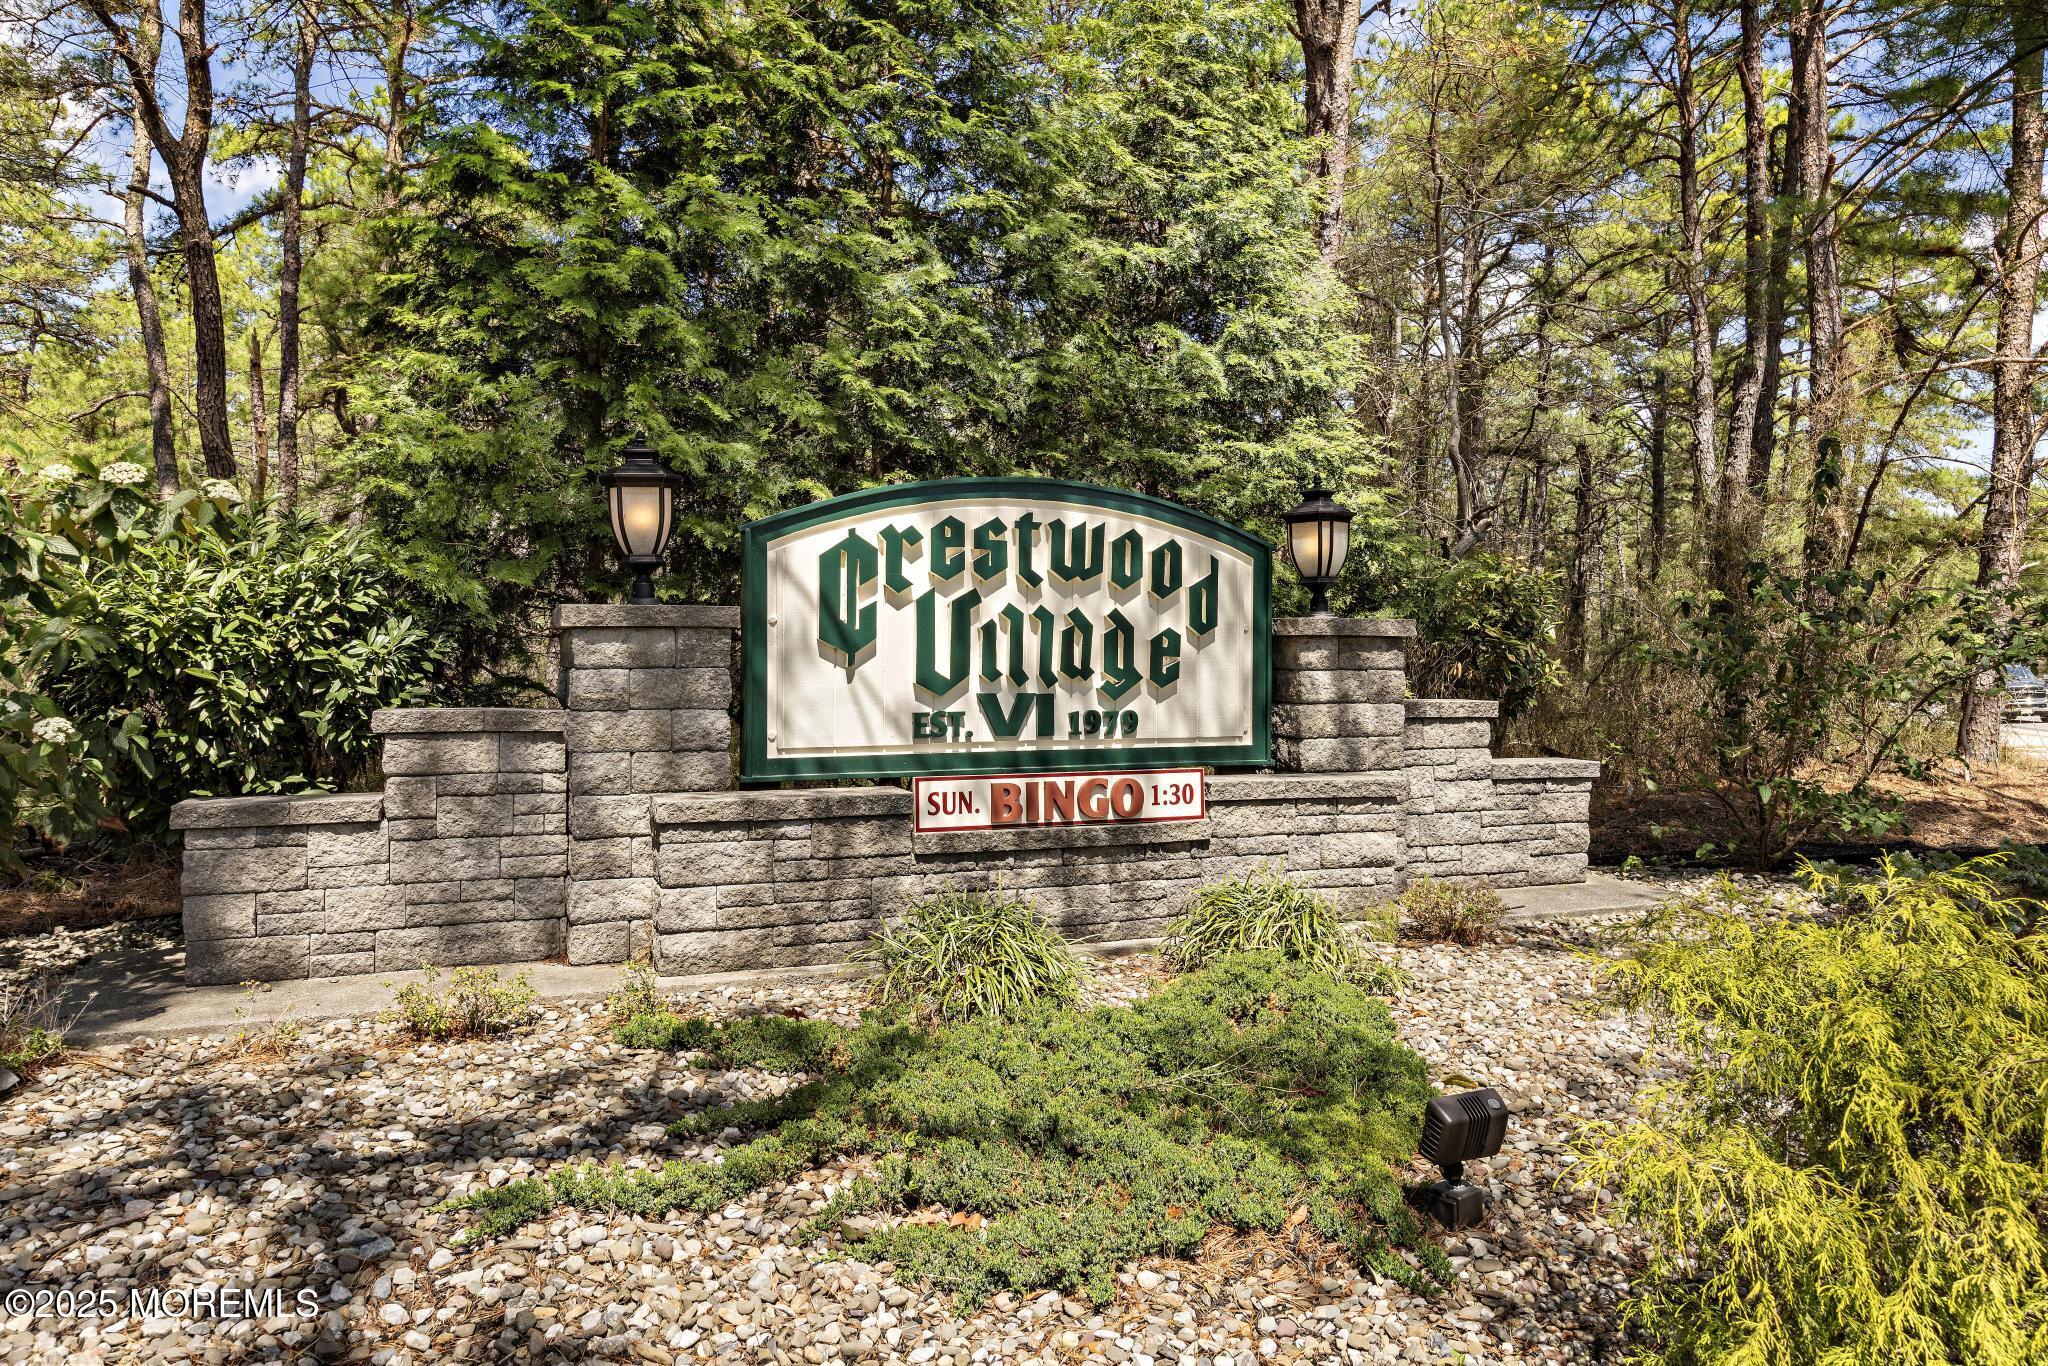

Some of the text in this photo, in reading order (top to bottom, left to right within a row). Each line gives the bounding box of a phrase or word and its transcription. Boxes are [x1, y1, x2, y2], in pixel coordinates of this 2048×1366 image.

[818, 512, 1219, 668] Crestwood
[914, 587, 1182, 701] Village
[913, 693, 1139, 738] EST. VI 1979
[927, 778, 1194, 823] SUN. BINGO 1:30
